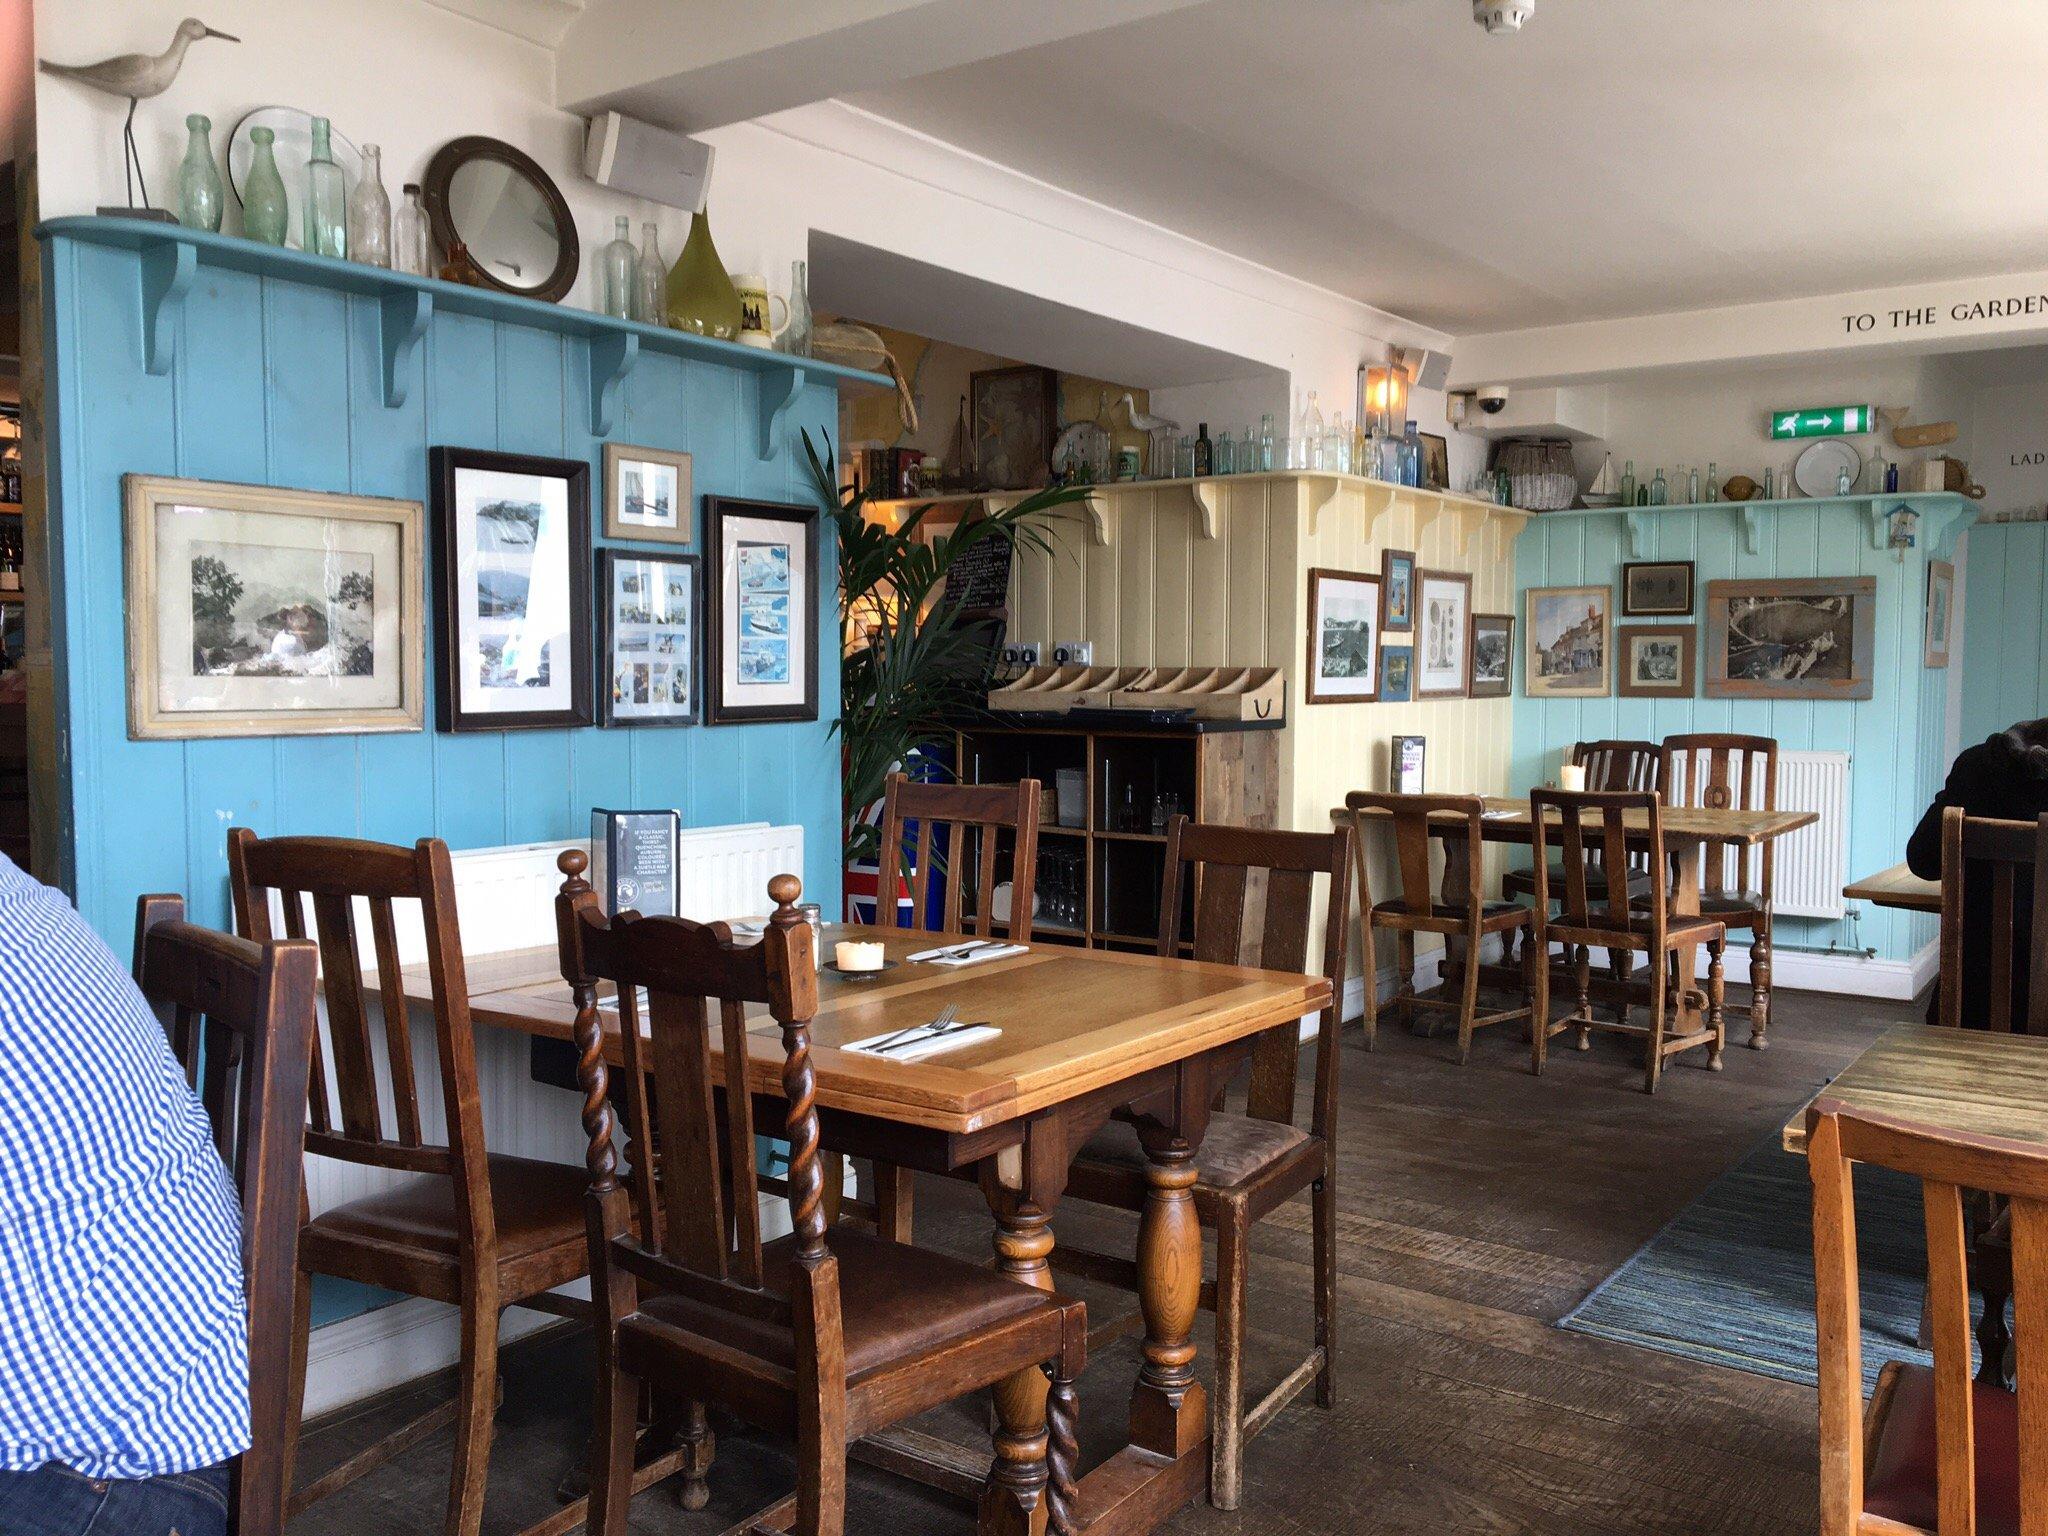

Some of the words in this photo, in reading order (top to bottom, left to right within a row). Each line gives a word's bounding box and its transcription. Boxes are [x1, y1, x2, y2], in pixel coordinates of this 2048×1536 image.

[1842, 314, 1875, 333] TO
[1888, 306, 1937, 328] THE
[2010, 453, 2045, 466] LAD
